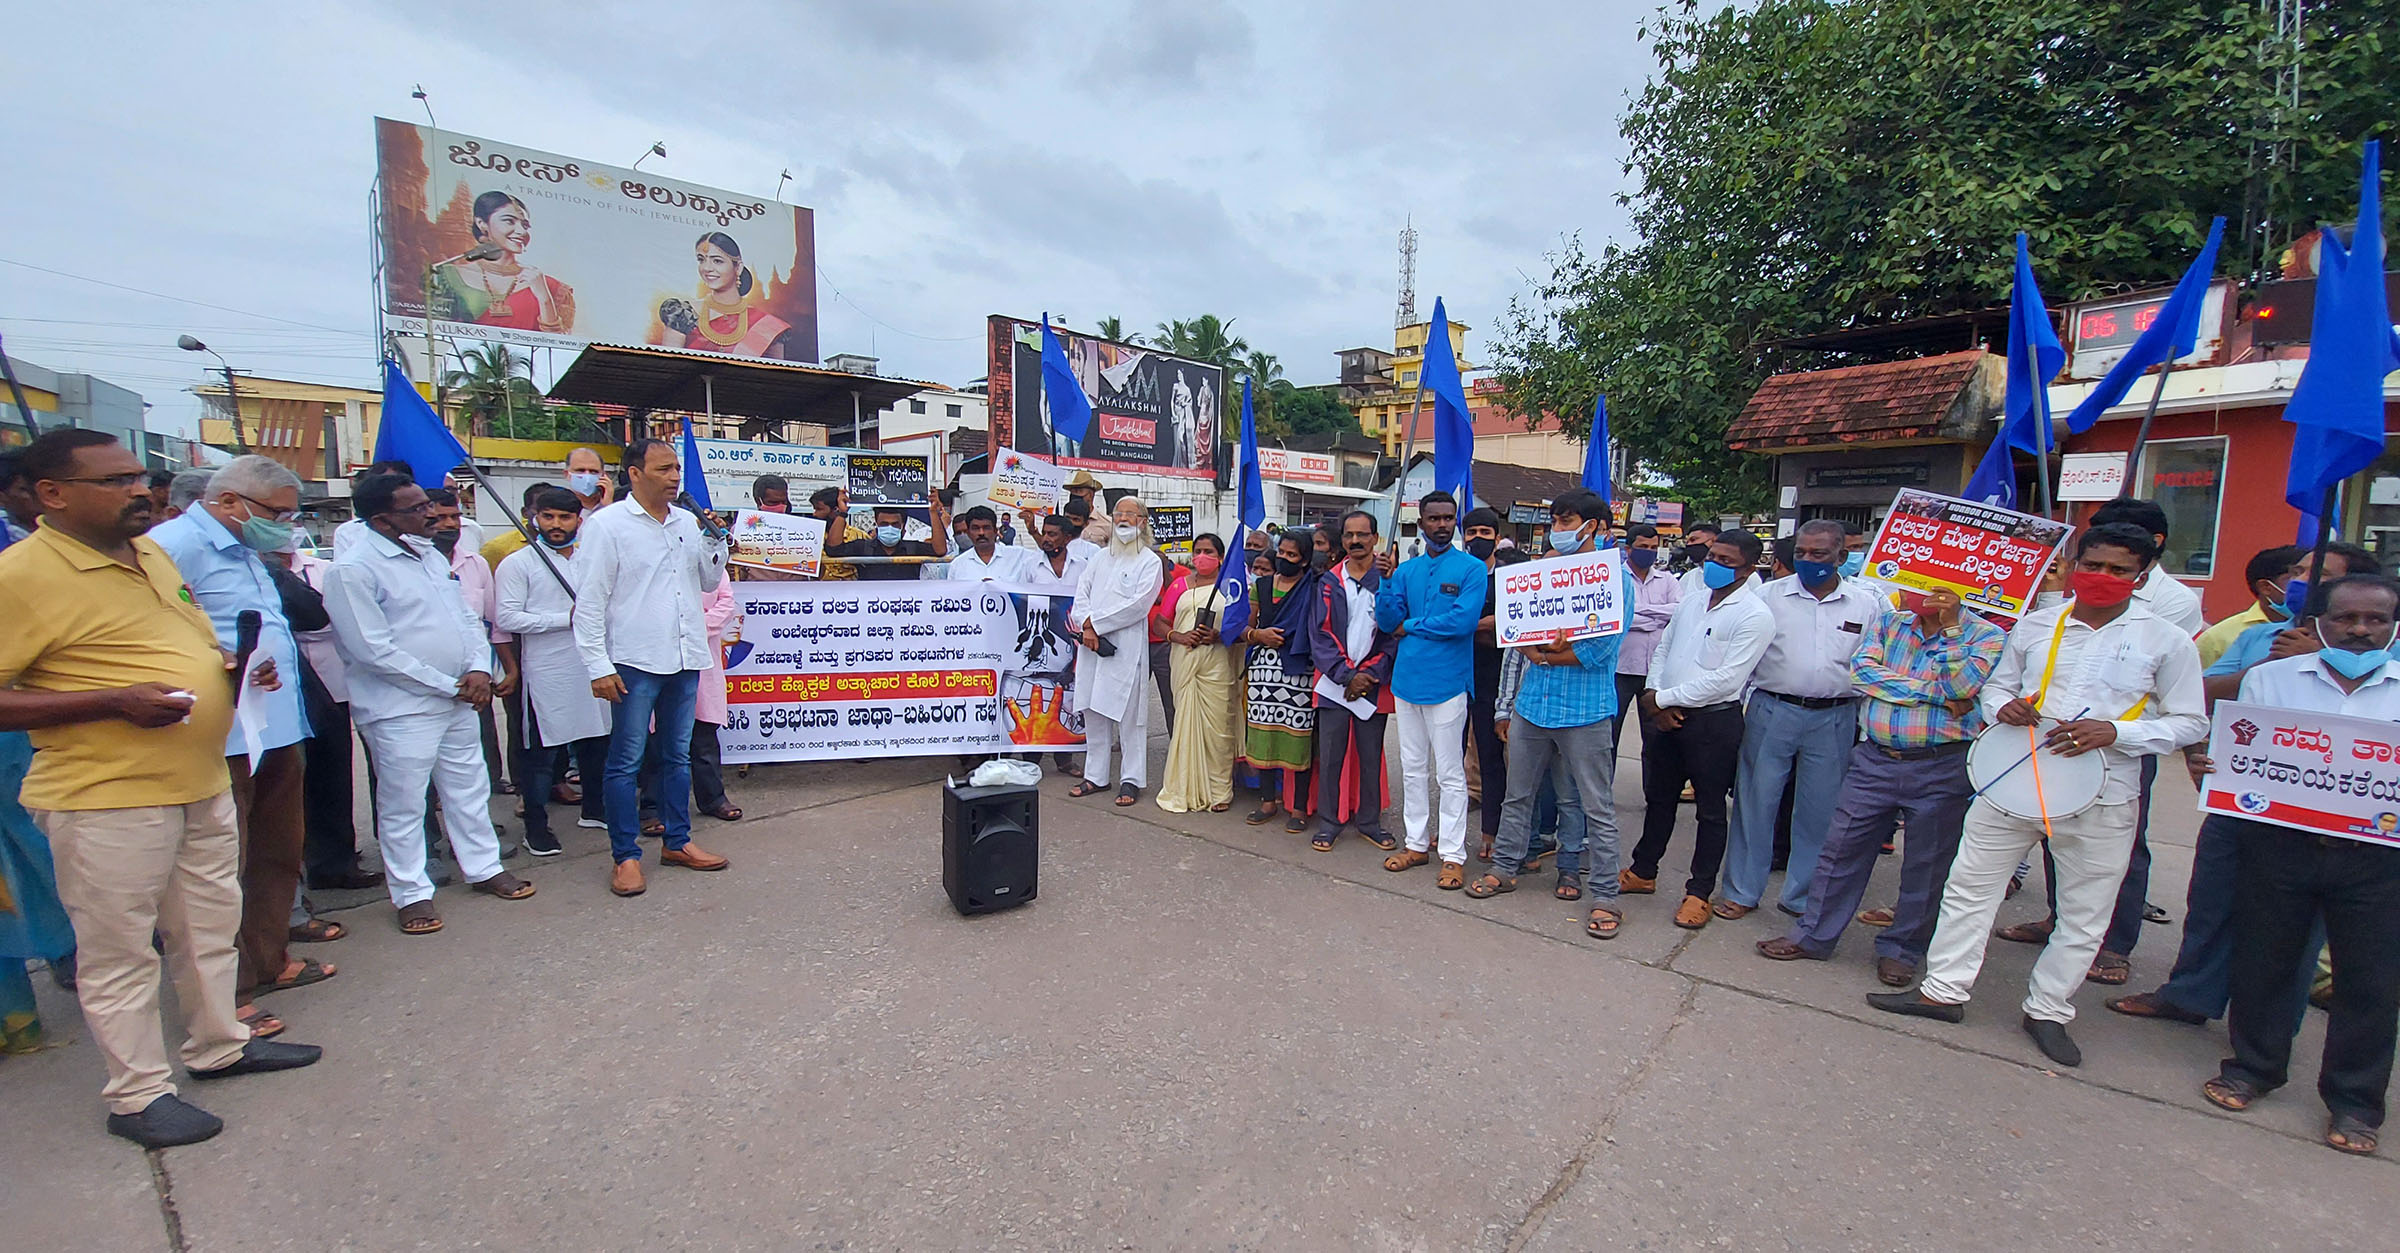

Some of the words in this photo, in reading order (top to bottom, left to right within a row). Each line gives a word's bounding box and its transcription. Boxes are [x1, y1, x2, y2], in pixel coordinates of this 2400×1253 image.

[518, 185, 592, 207] TRADITION
[597, 201, 613, 211] OF
[618, 204, 646, 217] FINE
[650, 211, 712, 229] JEWELLERY
[620, 179, 766, 226] ಆಲುಕ್ಕಾಸ್
[391, 301, 450, 312] PARAMARA
[400, 319, 423, 331] JOS
[434, 323, 488, 337] ALUKKAS
[512, 332, 531, 342] Shop
[533, 335, 556, 344] online:
[1098, 396, 1161, 414] AYALAKSHMI
[763, 452, 815, 465] ಕಾರ್ನಾಡ್
[819, 456, 827, 466] &
[1101, 449, 1118, 457] BEJAI,
[1120, 451, 1154, 460] MANGALORE
[850, 468, 873, 478] Hang
[1301, 458, 1328, 471] USHA
[850, 478, 867, 486] The
[2154, 471, 2216, 488] POLICE
[851, 487, 882, 497] Rapists
[1948, 504, 1982, 517] HORROR
[1981, 511, 1993, 519] OF
[1992, 513, 2019, 525] BEING
[1949, 514, 1974, 525] DALIT
[1972, 519, 1982, 527] IN
[1981, 521, 2006, 533] INDIA
[739, 546, 762, 556] ಜಾತಿ
[1889, 516, 1941, 541] ದಲಿತರ
[1941, 525, 1984, 552] ಮೇಲೆ
[1984, 535, 2042, 577] ದೌರ್ಜನ್ಯ
[1506, 571, 1542, 595] ದಲಿತ
[1550, 563, 1610, 589] ಮಗಳೂ
[745, 597, 814, 615] ಕರ್ನಾಟಕ
[822, 596, 860, 615] ದಲಿತ
[868, 595, 922, 616] ಸಂಘರ್ಷ
[931, 596, 972, 613] ಸಮಿತಿ
[980, 594, 1007, 616] (ರಿ.)
[1508, 600, 1524, 620] ಈ
[1529, 592, 1565, 618] ದೇಶದ
[1571, 584, 1613, 614] ಮಗಳೇ
[867, 624, 894, 641] ಜಿಲ್ಲಾ
[944, 622, 982, 636] ಉಡುಪಿ
[755, 649, 803, 670] ಸಹಬಾಳ್ವೆ
[809, 650, 839, 667] ಮತ್ತು
[845, 648, 894, 667] ಪ್ರಗತಿಪರ
[900, 646, 965, 662] ಸಂಘಟನೆಗಳ
[740, 677, 775, 693] ದಲಿತ
[837, 673, 900, 699] ಅತ್ಯಾಚಾರ
[906, 672, 940, 688] ಕೊಲೆ
[945, 671, 994, 695] ದೌರ್ಜನ್ಯ
[760, 704, 839, 738] ಪ್ರತಿಭಟನಾ
[2272, 723, 2333, 763] ನಮ್ಮ
